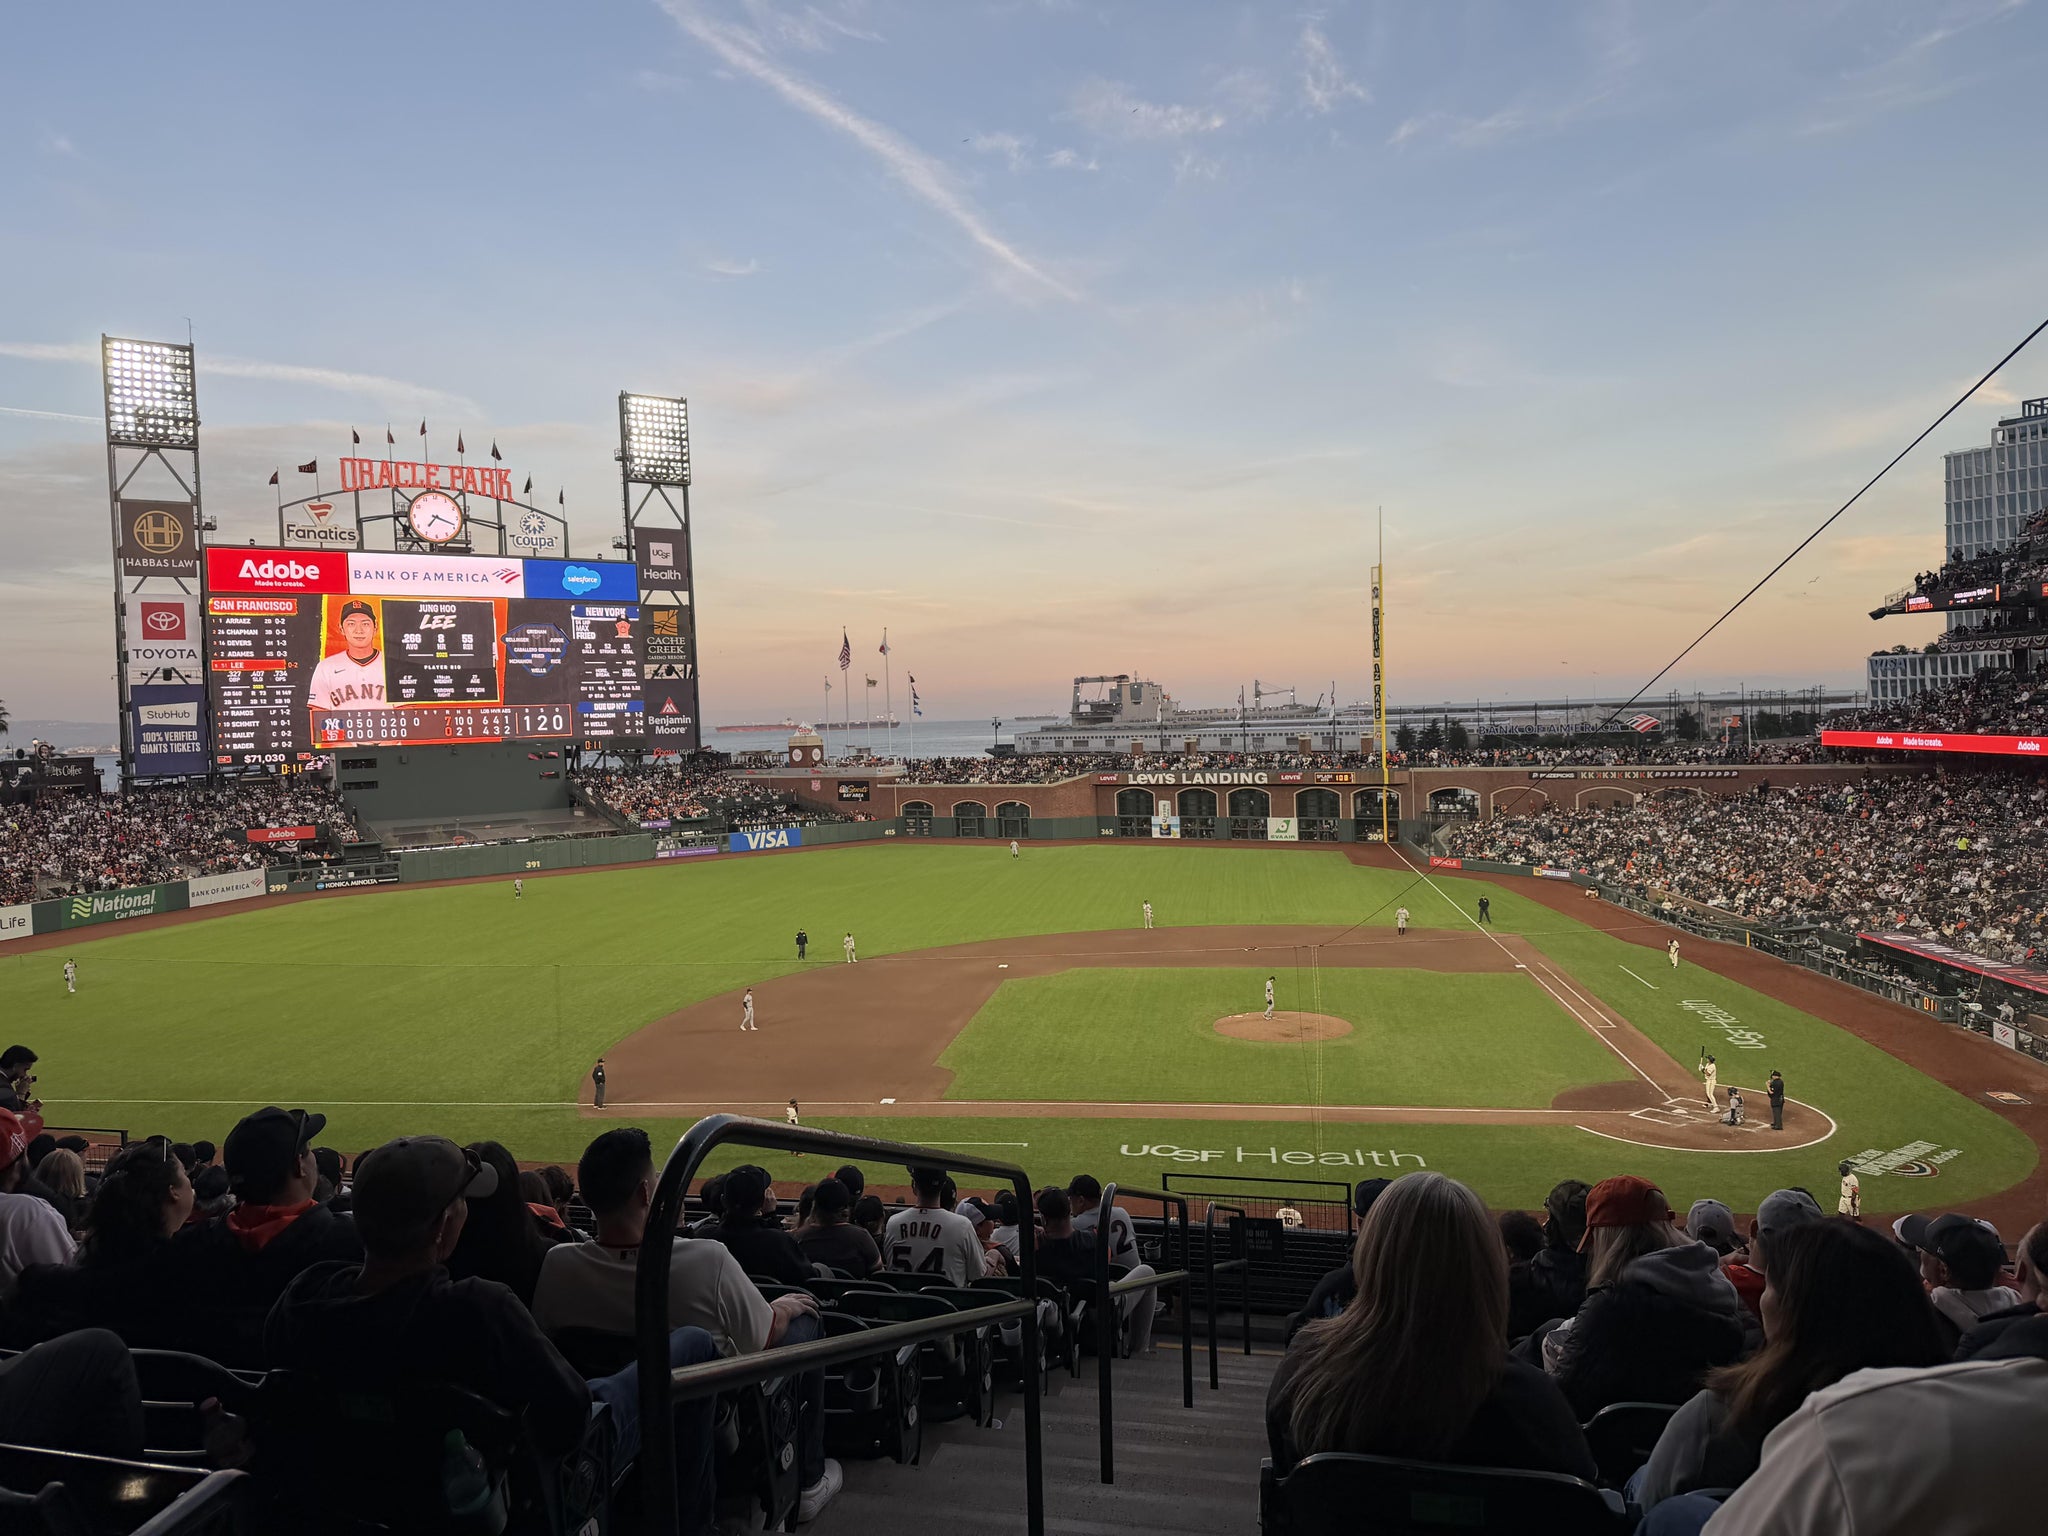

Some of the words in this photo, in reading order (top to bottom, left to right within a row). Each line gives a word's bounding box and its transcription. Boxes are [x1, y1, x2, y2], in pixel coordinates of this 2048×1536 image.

[340, 457, 440, 492] ORACLE
[448, 465, 516, 503] PARK
[286, 524, 356, 541] Fanatics
[515, 536, 554, 549] coupa
[652, 550, 671, 560] UCSF
[126, 558, 169, 567] HABBAS
[172, 559, 194, 568] LAW
[238, 559, 320, 580] Adobe
[644, 568, 681, 580] Health
[354, 569, 396, 581] BANK
[400, 571, 419, 582] OF
[422, 572, 490, 583] AMERICA
[568, 575, 598, 584] salesforce
[214, 600, 234, 610] SAN
[236, 600, 293, 611] FRANCISCO
[418, 604, 439, 613] JUNG
[440, 604, 456, 612] HOO
[586, 607, 605, 616] NEW
[605, 608, 626, 616] YORK
[420, 614, 457, 630] LEE
[437, 634, 445, 643] 8
[462, 634, 473, 643] 55
[647, 636, 686, 645] CACHE
[132, 648, 197, 659] TOYOTA
[648, 646, 684, 654] CREEK
[1870, 658, 1906, 671] VISA
[146, 710, 190, 719] StubHub
[648, 715, 691, 726] Benjamin
[346, 719, 353, 728] 0
[357, 720, 363, 728] 5
[366, 719, 372, 728] 0
[381, 719, 387, 728] 0
[390, 718, 397, 727] 2
[400, 718, 406, 727] 0
[413, 718, 420, 726] 0
[445, 716, 451, 726] 7
[455, 716, 464, 726] 10
[467, 716, 473, 725] 0
[482, 716, 488, 725] 6
[493, 716, 500, 724] 4
[504, 716, 509, 724] 1
[524, 716, 530, 731] 1
[537, 715, 548, 730] 2
[553, 715, 563, 730] 0
[347, 730, 353, 738] 0
[357, 730, 363, 738] 0
[367, 730, 373, 738] 0
[381, 729, 387, 738] 0
[391, 729, 397, 737] 0
[401, 728, 407, 737] 0
[445, 727, 452, 736] 0
[456, 727, 462, 736] 2
[468, 727, 472, 735] 1
[482, 726, 489, 735] 4
[494, 726, 500, 734] 3
[504, 726, 510, 734] 2
[655, 726, 685, 734] Moore
[1479, 725, 1520, 735] BANK
[1525, 725, 1545, 734] OF
[1550, 723, 1621, 734] AMERICA
[142, 732, 163, 742] 100%
[164, 731, 197, 741] VERIFIED
[140, 743, 168, 754] GIANTS
[170, 742, 200, 752] TICKETS
[1876, 736, 1892, 744] Adobe
[1903, 737, 1917, 745] Made
[1924, 738, 1943, 747] create.
[2017, 740, 2040, 751] Adobe
[244, 754, 285, 763] $71,030
[653, 747, 676, 758] Coors
[62, 765, 82, 777] Coffee
[1182, 772, 1268, 784] LANDING
[268, 830, 296, 839] Adobe
[744, 831, 789, 849] VISA
[269, 884, 287, 892] 399
[325, 881, 350, 889] KONICA
[350, 878, 377, 886] MINOLTA
[192, 889, 209, 897] BANK
[221, 883, 250, 893] AMERICA
[93, 889, 156, 914] National
[115, 911, 128, 920] Car
[129, 906, 153, 917] Rental
[0, 917, 26, 930] Life
[1120, 1144, 1225, 1162] UCSF
[1236, 1146, 1427, 1167] Health
[1284, 1216, 1293, 1225] 10
[900, 1222, 943, 1240] ROMO
[892, 1246, 945, 1275] 54
